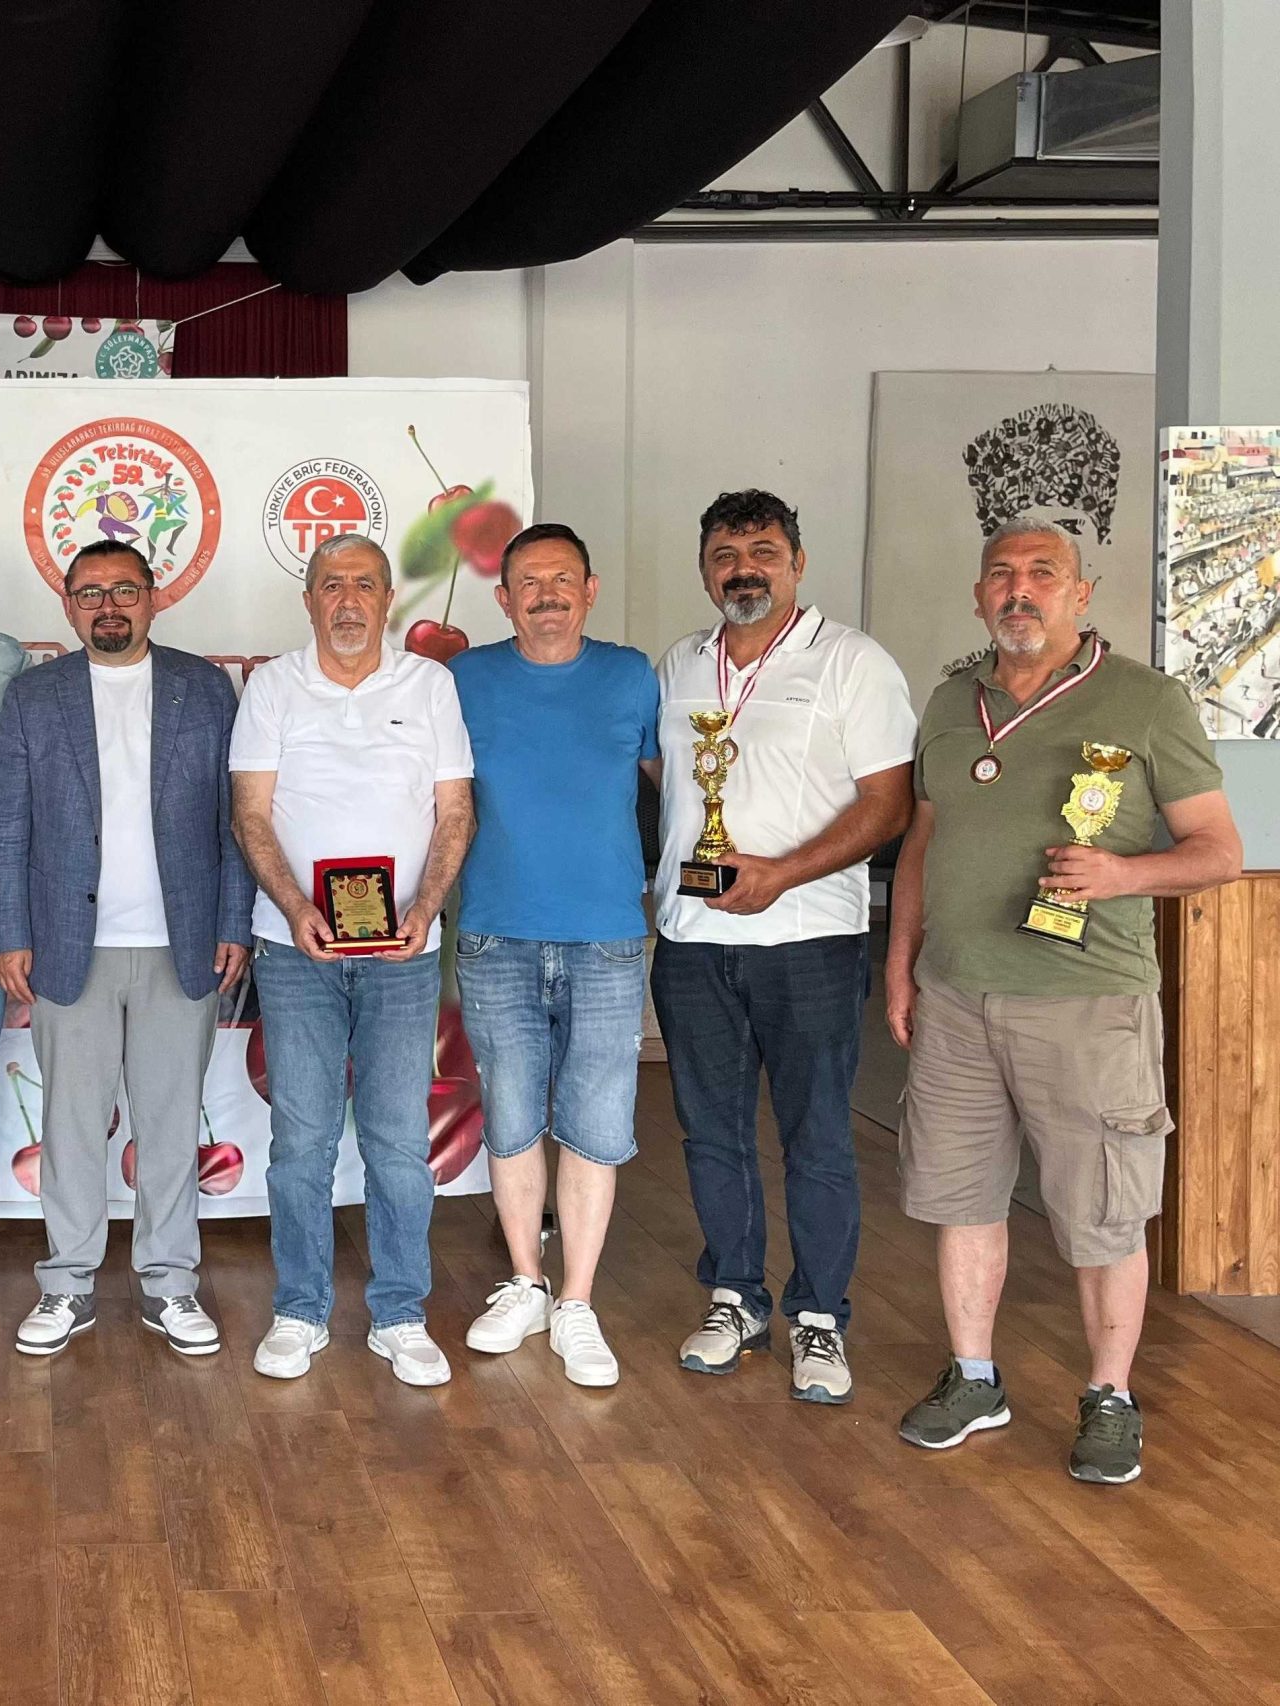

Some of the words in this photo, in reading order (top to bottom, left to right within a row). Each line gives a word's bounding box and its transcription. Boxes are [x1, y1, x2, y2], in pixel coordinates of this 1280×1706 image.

[112, 463, 144, 486] 59.
[266, 476, 294, 530] TÜRKİYE
[292, 461, 322, 480] BRİÇ
[324, 461, 382, 531] FEDERASYONU
